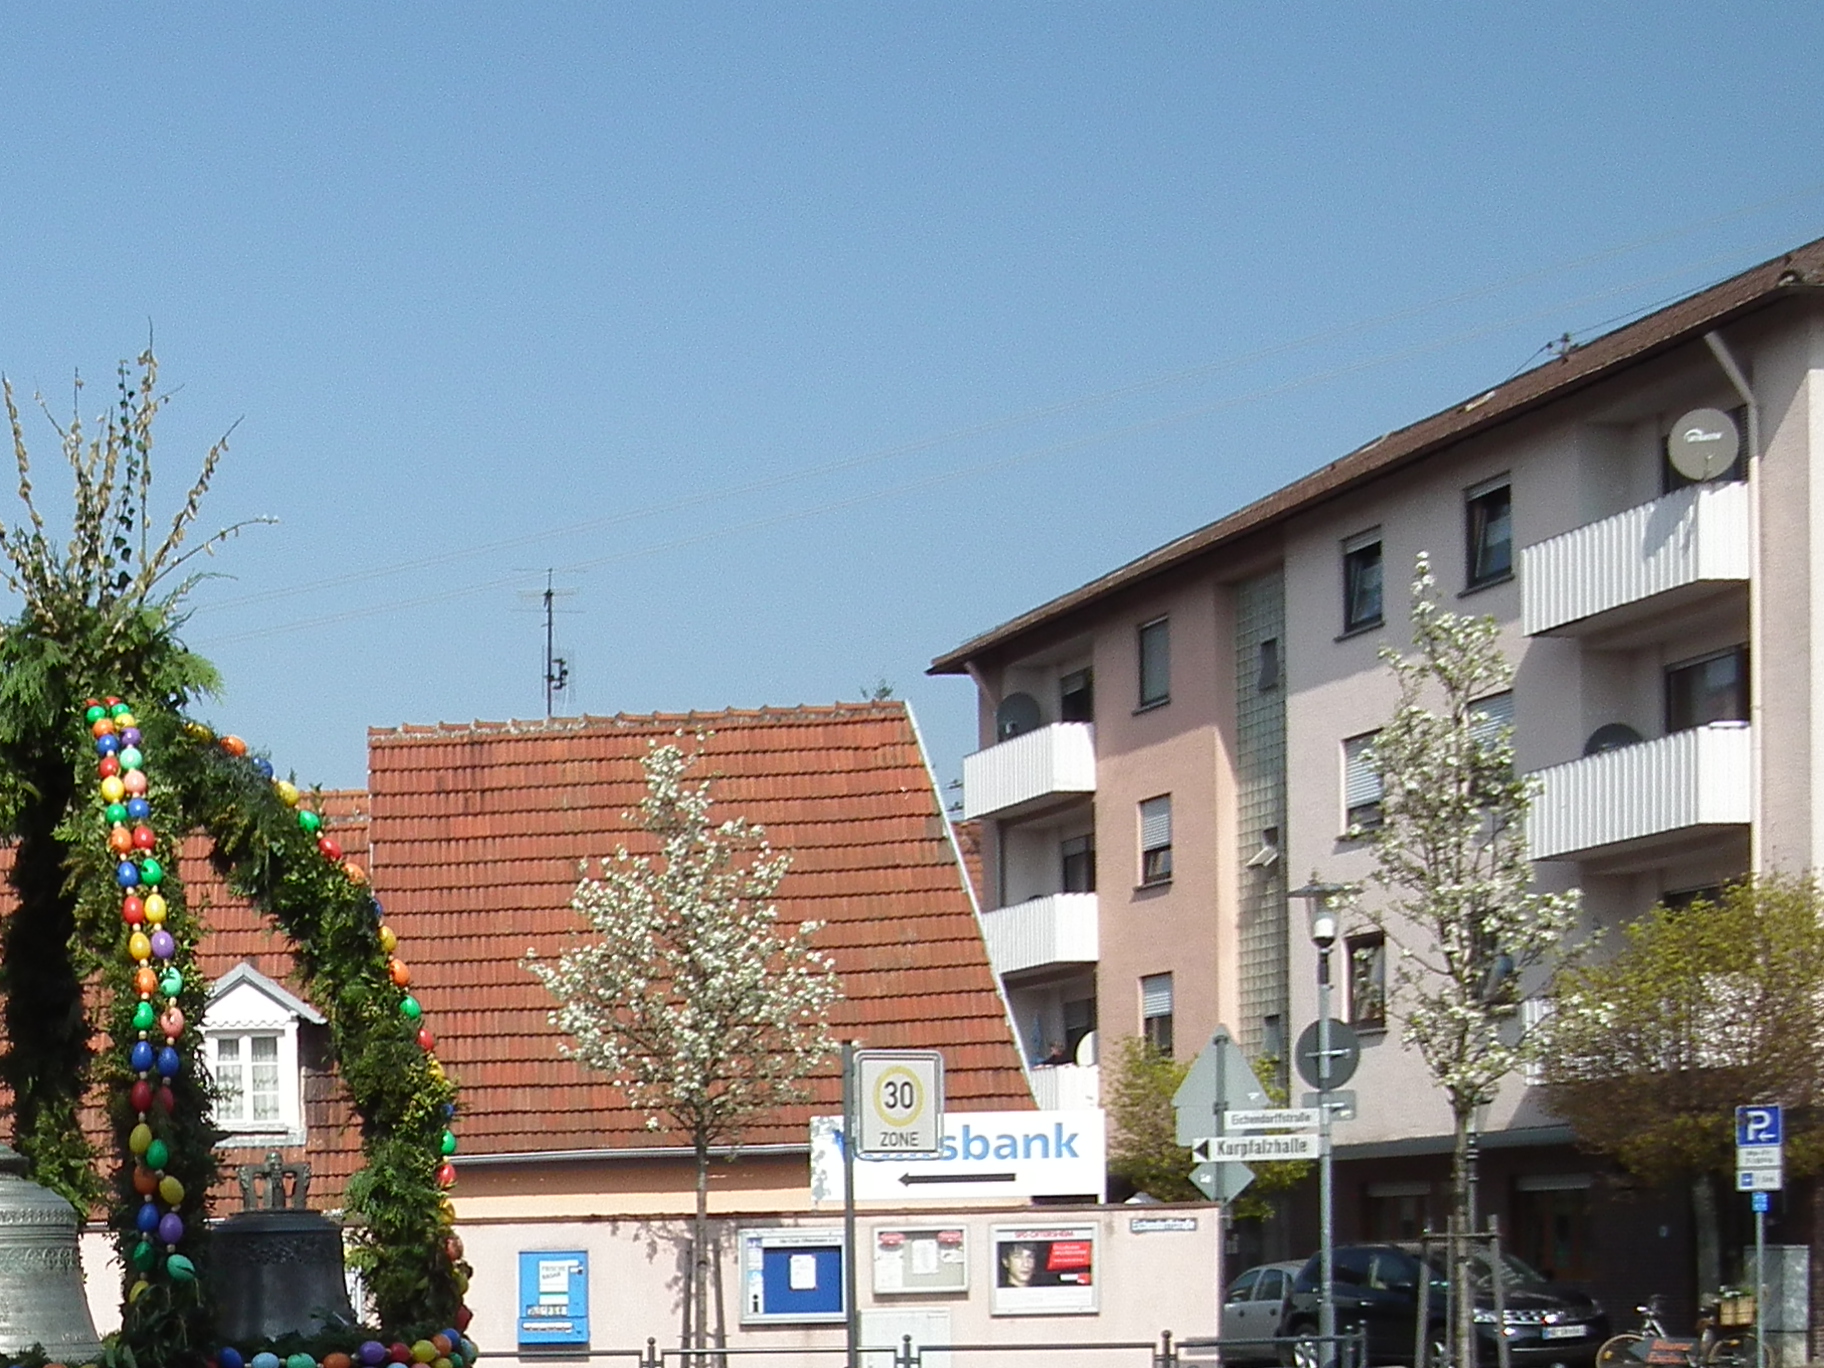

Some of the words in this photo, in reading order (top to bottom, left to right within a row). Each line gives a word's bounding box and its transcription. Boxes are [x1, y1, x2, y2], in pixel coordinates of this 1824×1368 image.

[884, 1081, 914, 1109] 30
[1230, 1113, 1312, 1125] Eichendorffstraße
[1747, 1110, 1771, 1141] P
[879, 1131, 920, 1147] ZONE
[1216, 1137, 1307, 1157] Kurpfalzhalle
